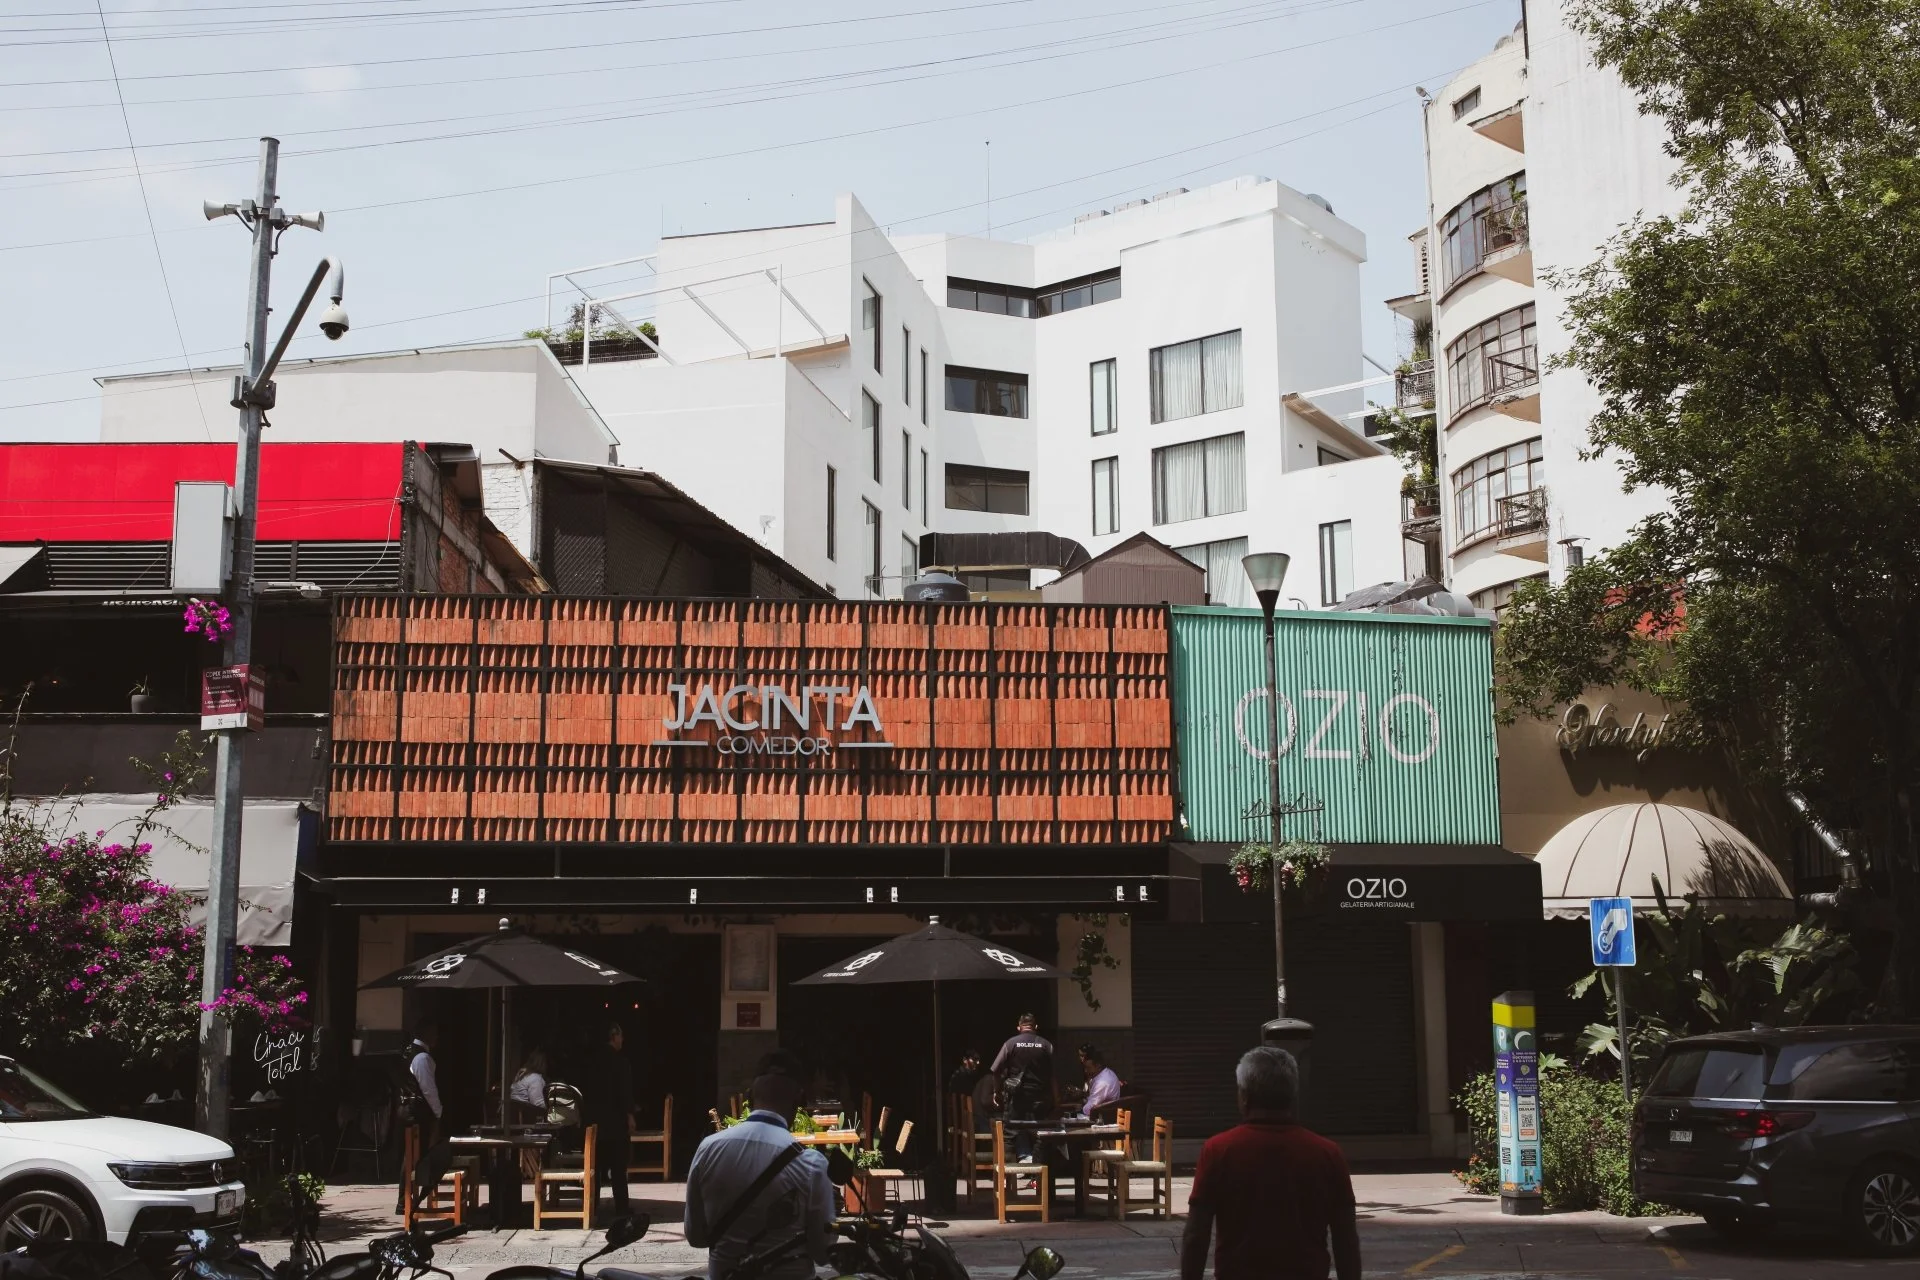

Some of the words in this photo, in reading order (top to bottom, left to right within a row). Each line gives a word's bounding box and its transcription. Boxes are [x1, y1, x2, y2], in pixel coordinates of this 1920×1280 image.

[662, 684, 883, 732] JACINTA
[1234, 687, 1440, 764] OZIO
[716, 735, 831, 756] COMEDOR
[1346, 877, 1407, 899] OZIO
[1374, 901, 1415, 909] ARTIGIANALE
[261, 1046, 302, 1085] Total
